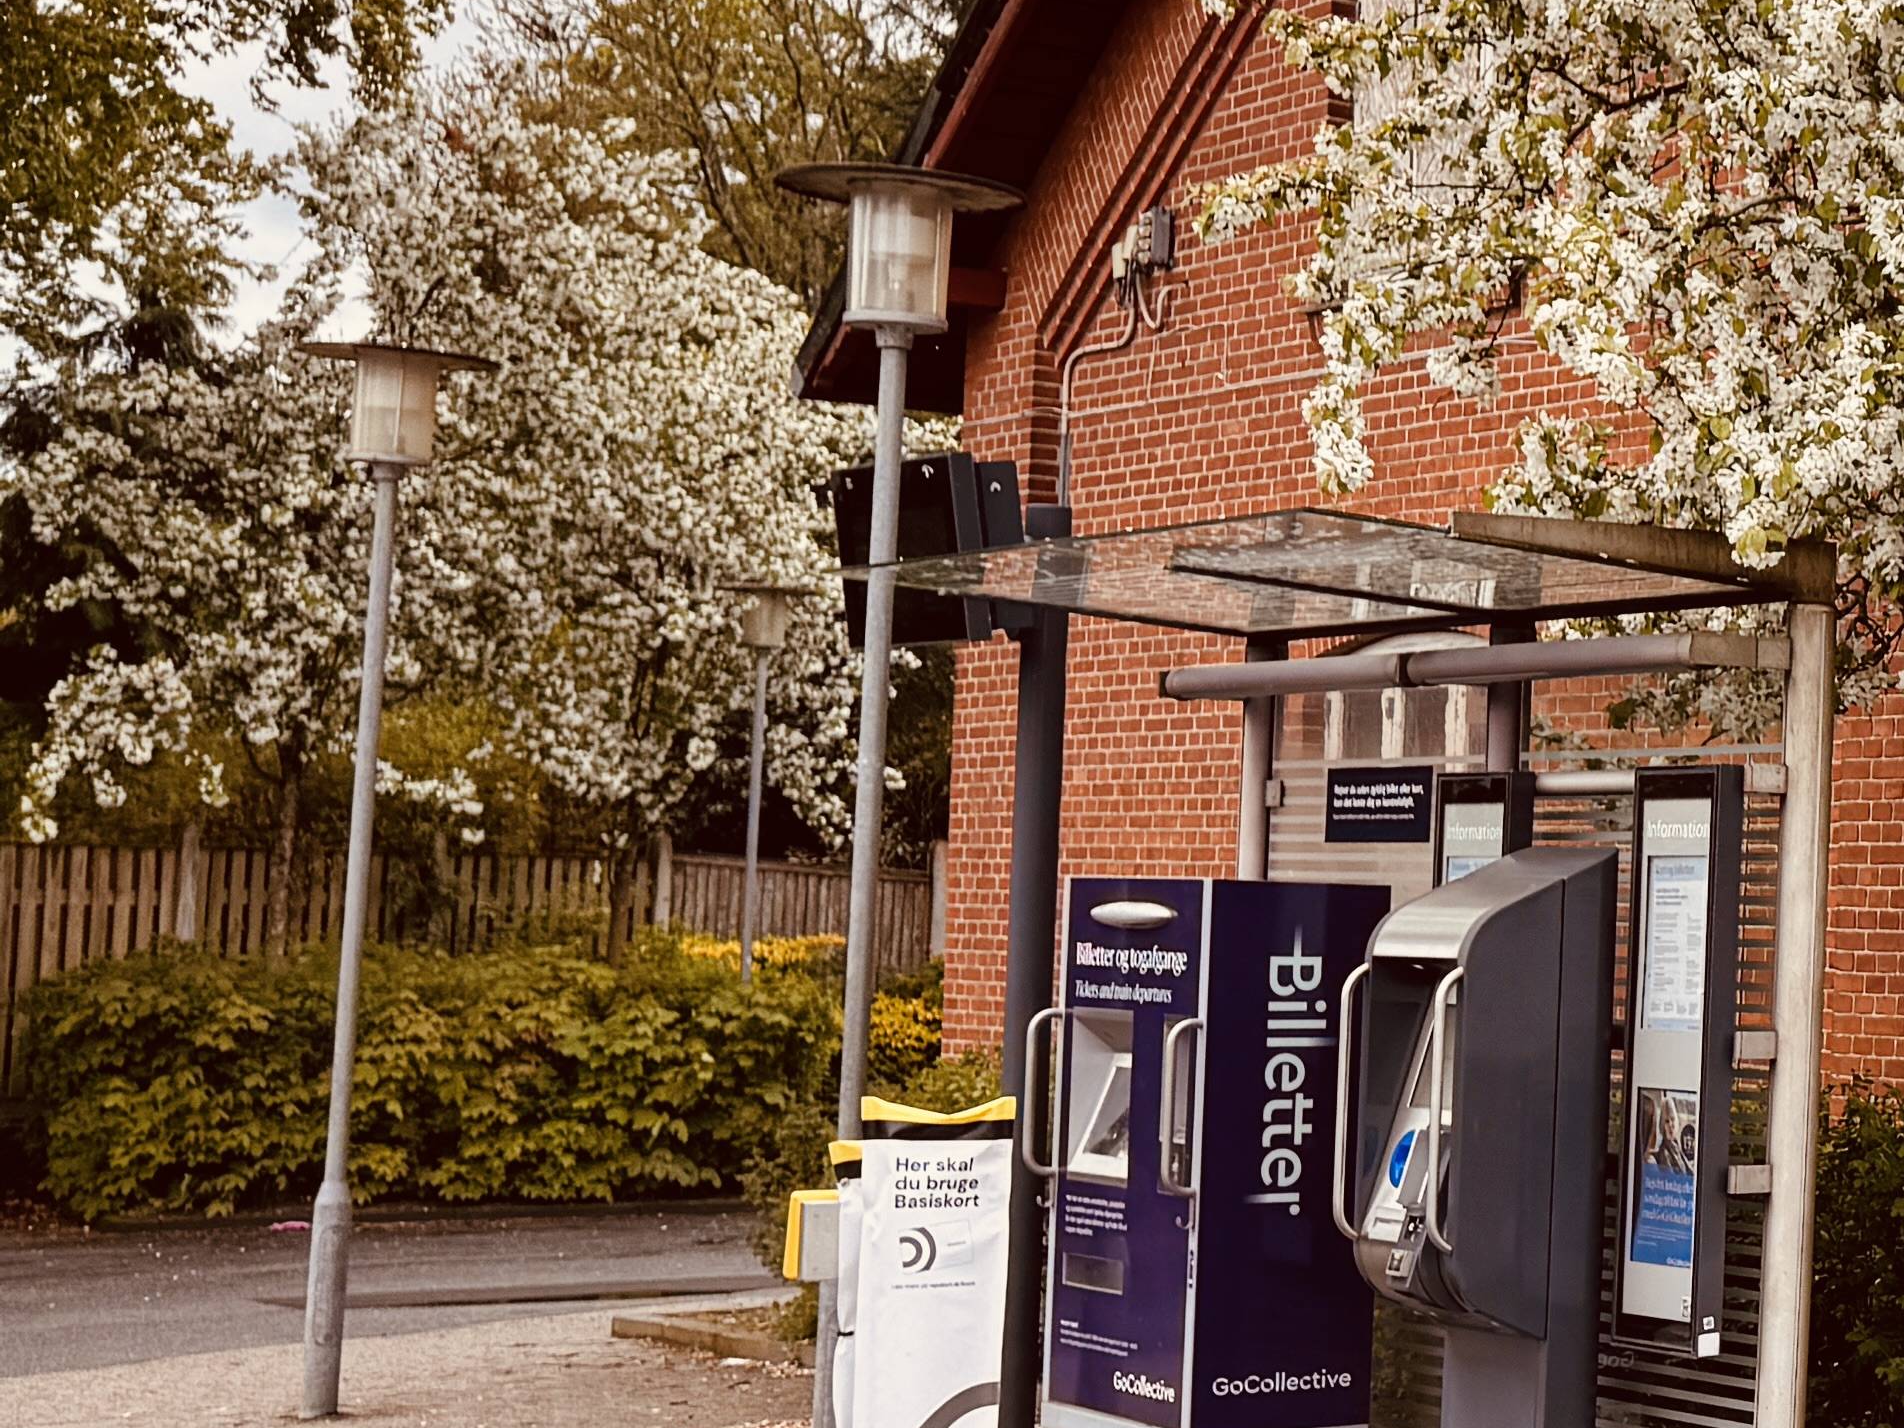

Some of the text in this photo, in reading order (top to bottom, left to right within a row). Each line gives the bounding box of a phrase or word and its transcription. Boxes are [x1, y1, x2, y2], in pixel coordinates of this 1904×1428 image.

[1076, 942, 1188, 977] Billetter og togafgange
[1075, 979, 1099, 998] Tickets
[1253, 928, 1336, 1216] Billetter
[896, 1157, 974, 1172] Her skal
[895, 1176, 979, 1194] du bruge
[895, 1193, 980, 1209] Basiskort
[1113, 1371, 1176, 1403] GoCollective
[1212, 1368, 1352, 1396] GoCollective
